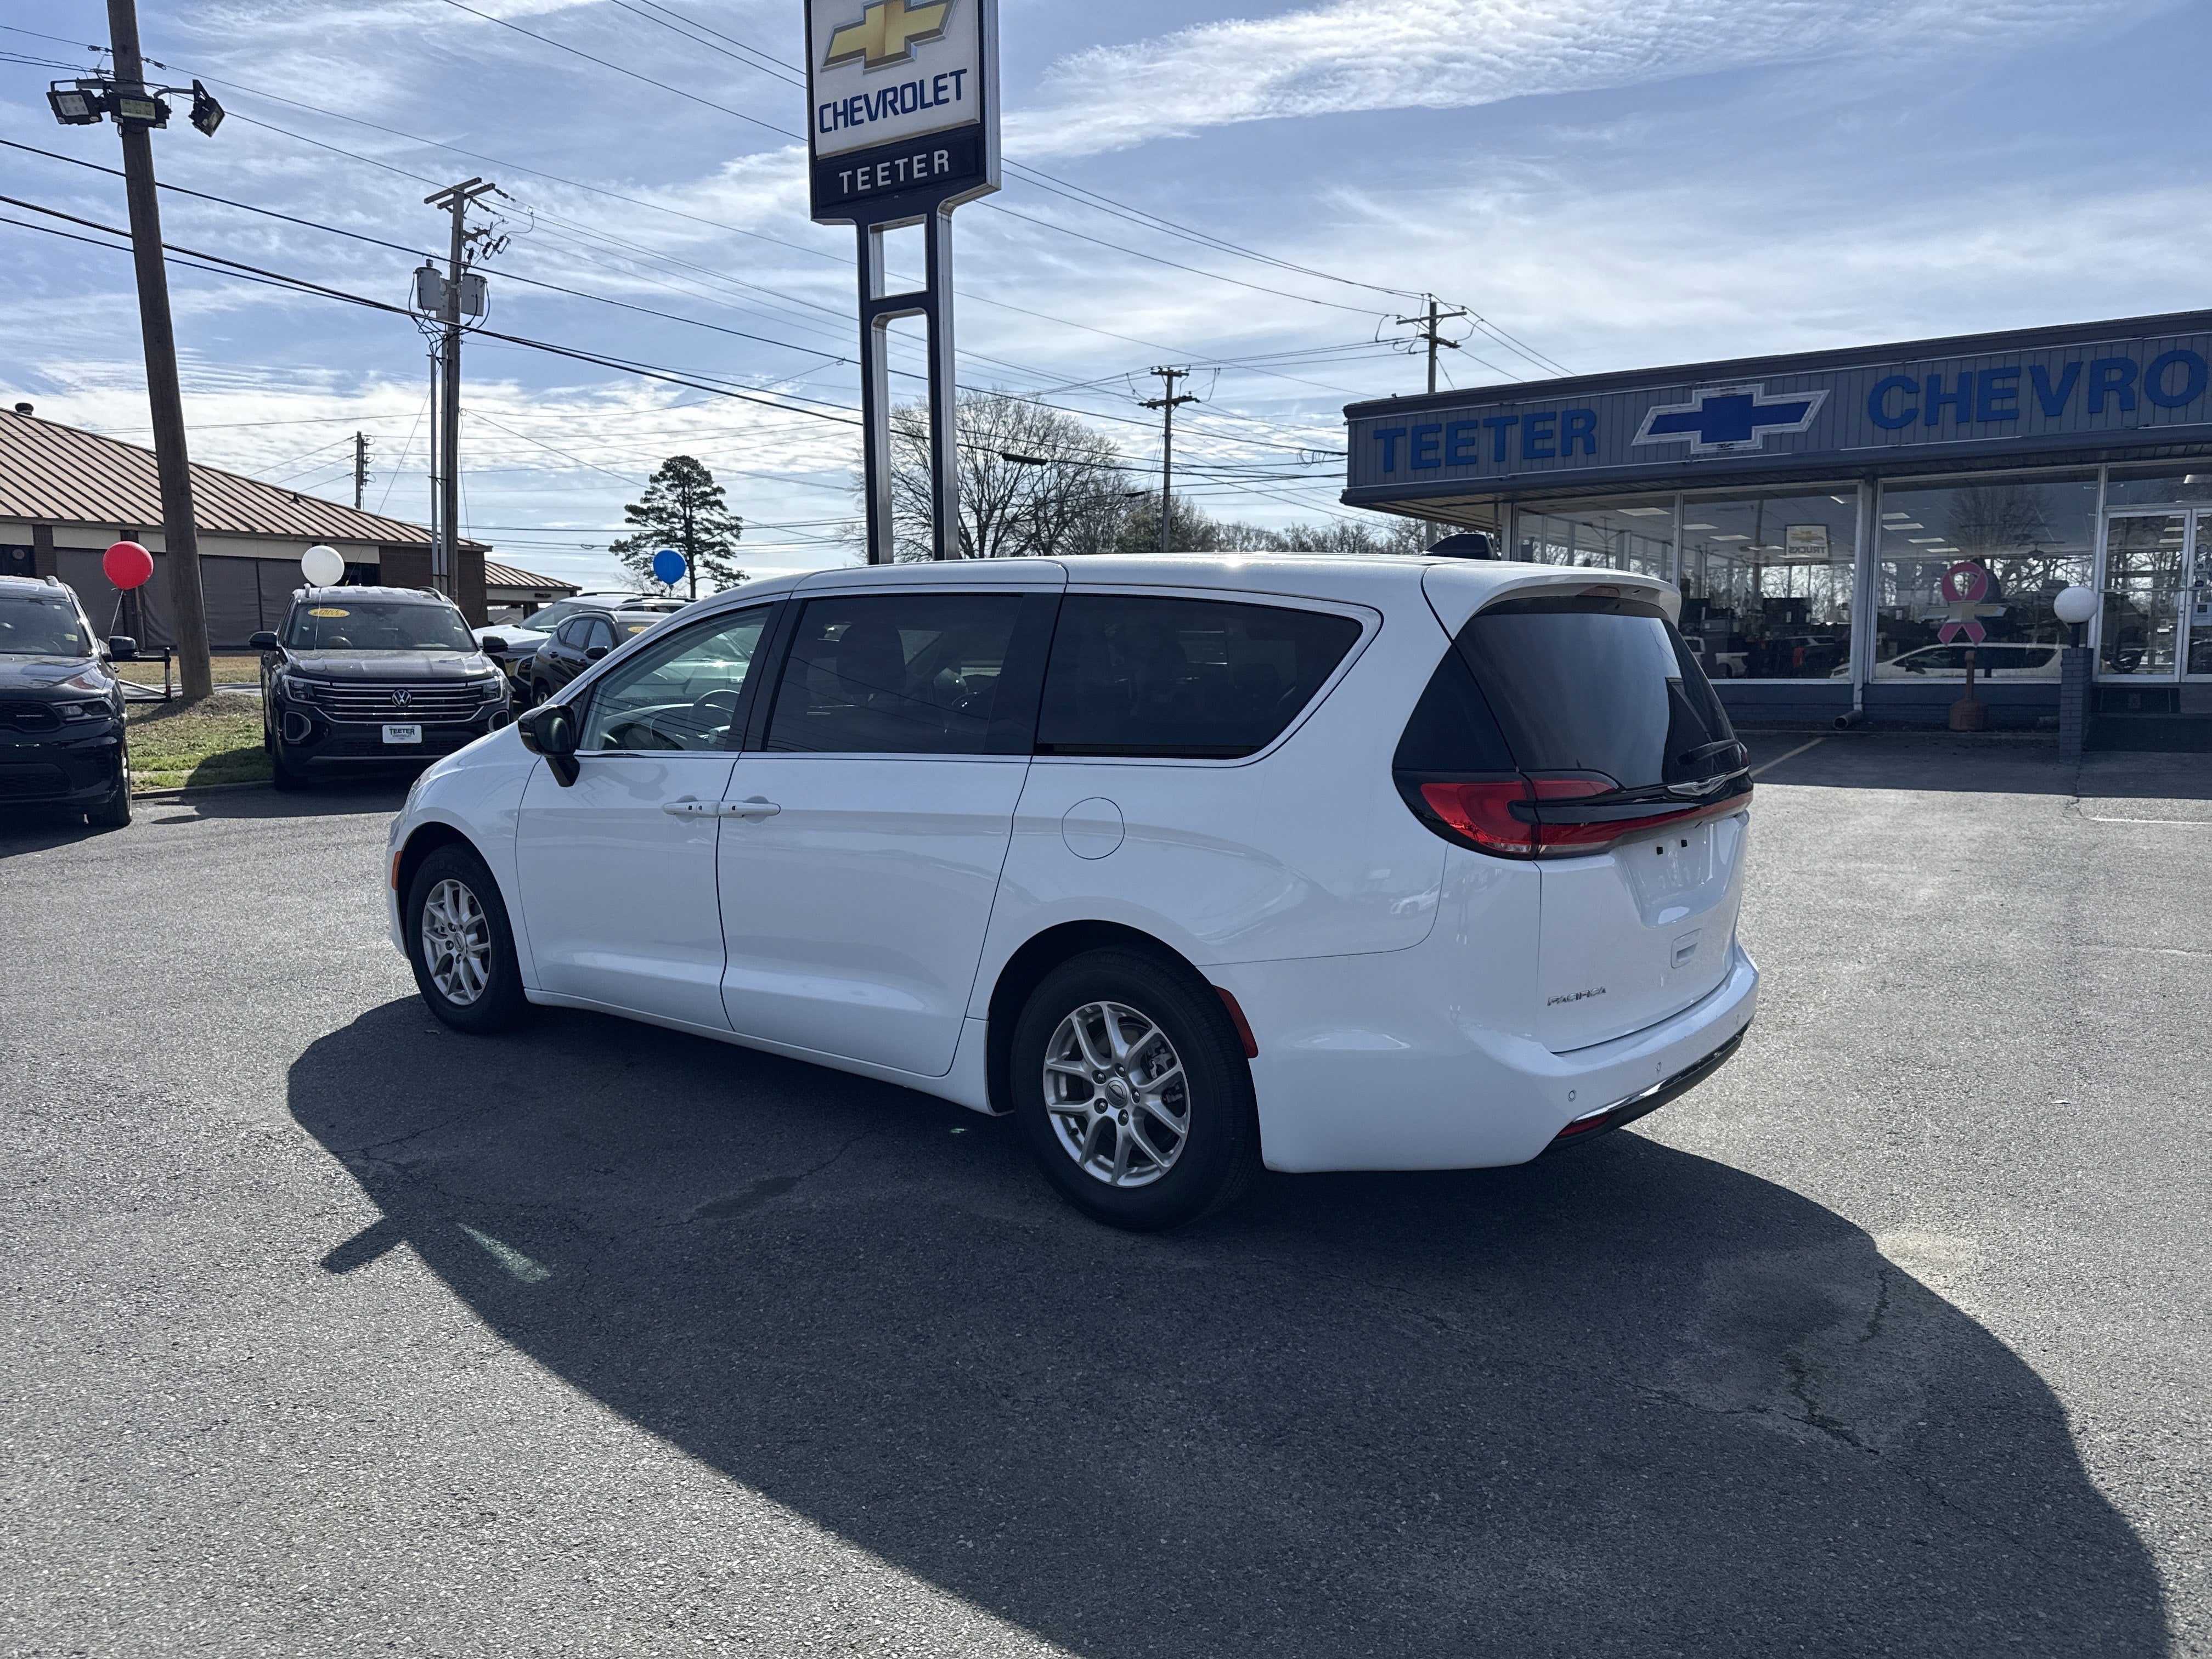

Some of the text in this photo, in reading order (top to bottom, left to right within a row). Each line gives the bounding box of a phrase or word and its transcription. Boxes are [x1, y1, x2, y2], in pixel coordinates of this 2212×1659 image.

[819, 69, 967, 133] CHEVROLET
[839, 149, 950, 194] TEETER
[1373, 349, 2208, 472] TEETER CHEVRO
[1548, 986, 1606, 1006] PACIFICA
